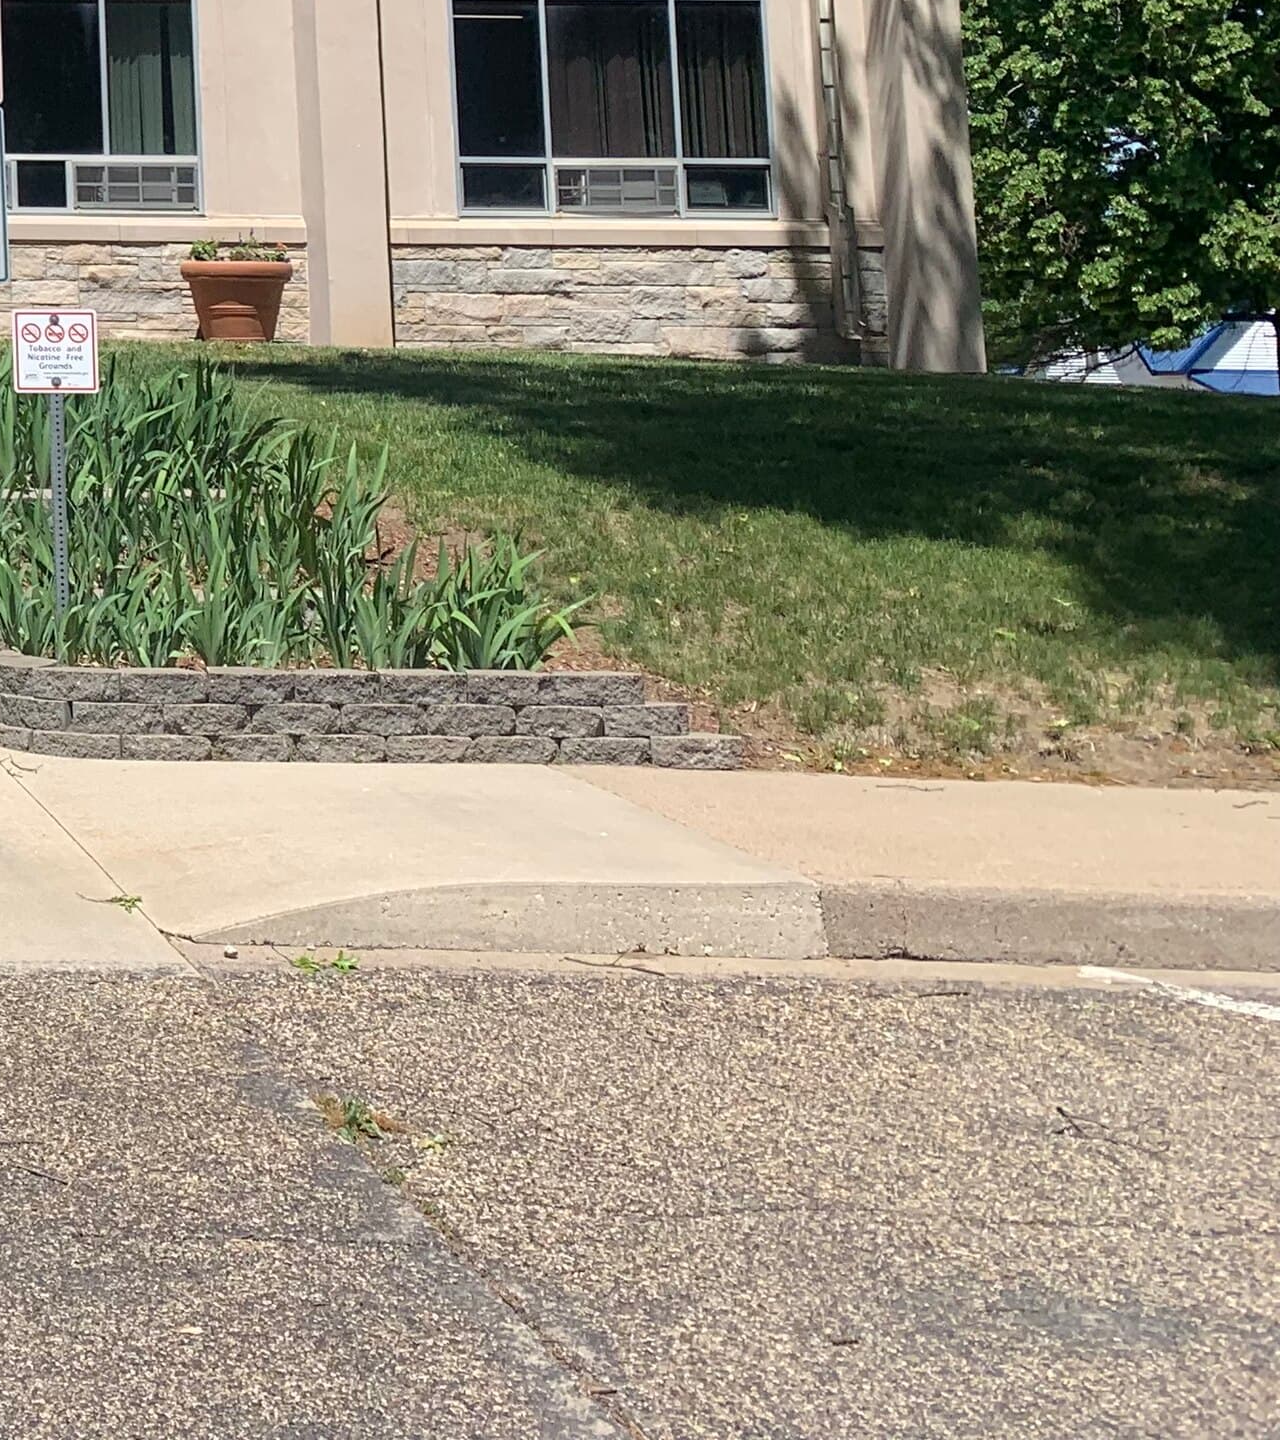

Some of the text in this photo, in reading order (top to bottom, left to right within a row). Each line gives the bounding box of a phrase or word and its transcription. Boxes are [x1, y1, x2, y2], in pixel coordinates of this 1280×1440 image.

[28, 344, 82, 352] Tobacco and
[27, 353, 84, 361] Nicotine Free
[38, 362, 73, 370] Grounds
